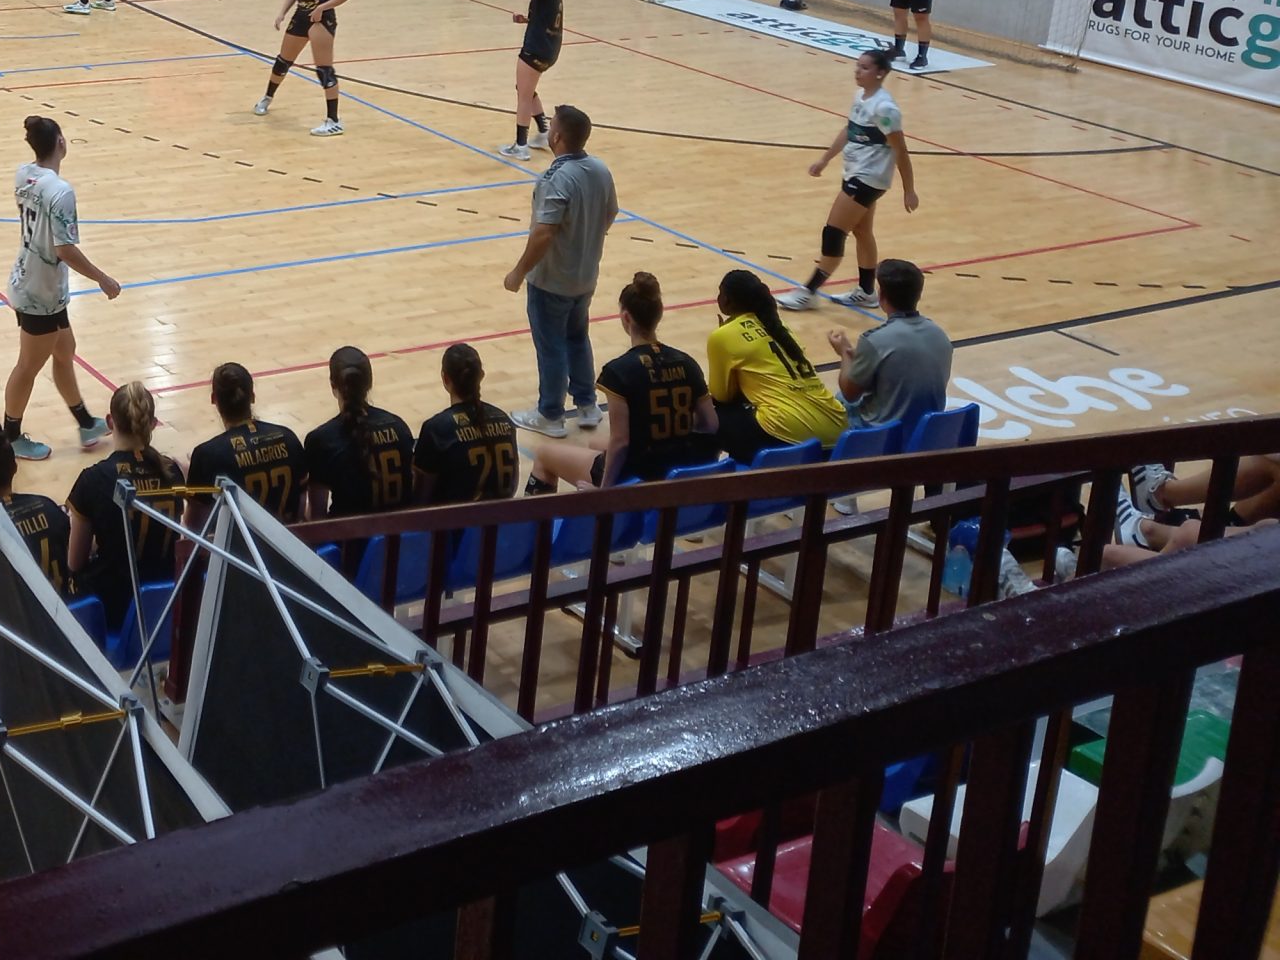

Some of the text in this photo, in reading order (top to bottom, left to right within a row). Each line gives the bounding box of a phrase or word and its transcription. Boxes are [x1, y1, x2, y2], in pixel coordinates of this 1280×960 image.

[1088, 20, 1236, 63] RUGS FOR YOUR HOME
[649, 386, 693, 440] 58
[235, 442, 289, 468] MILAGROS
[467, 442, 514, 502] 26
